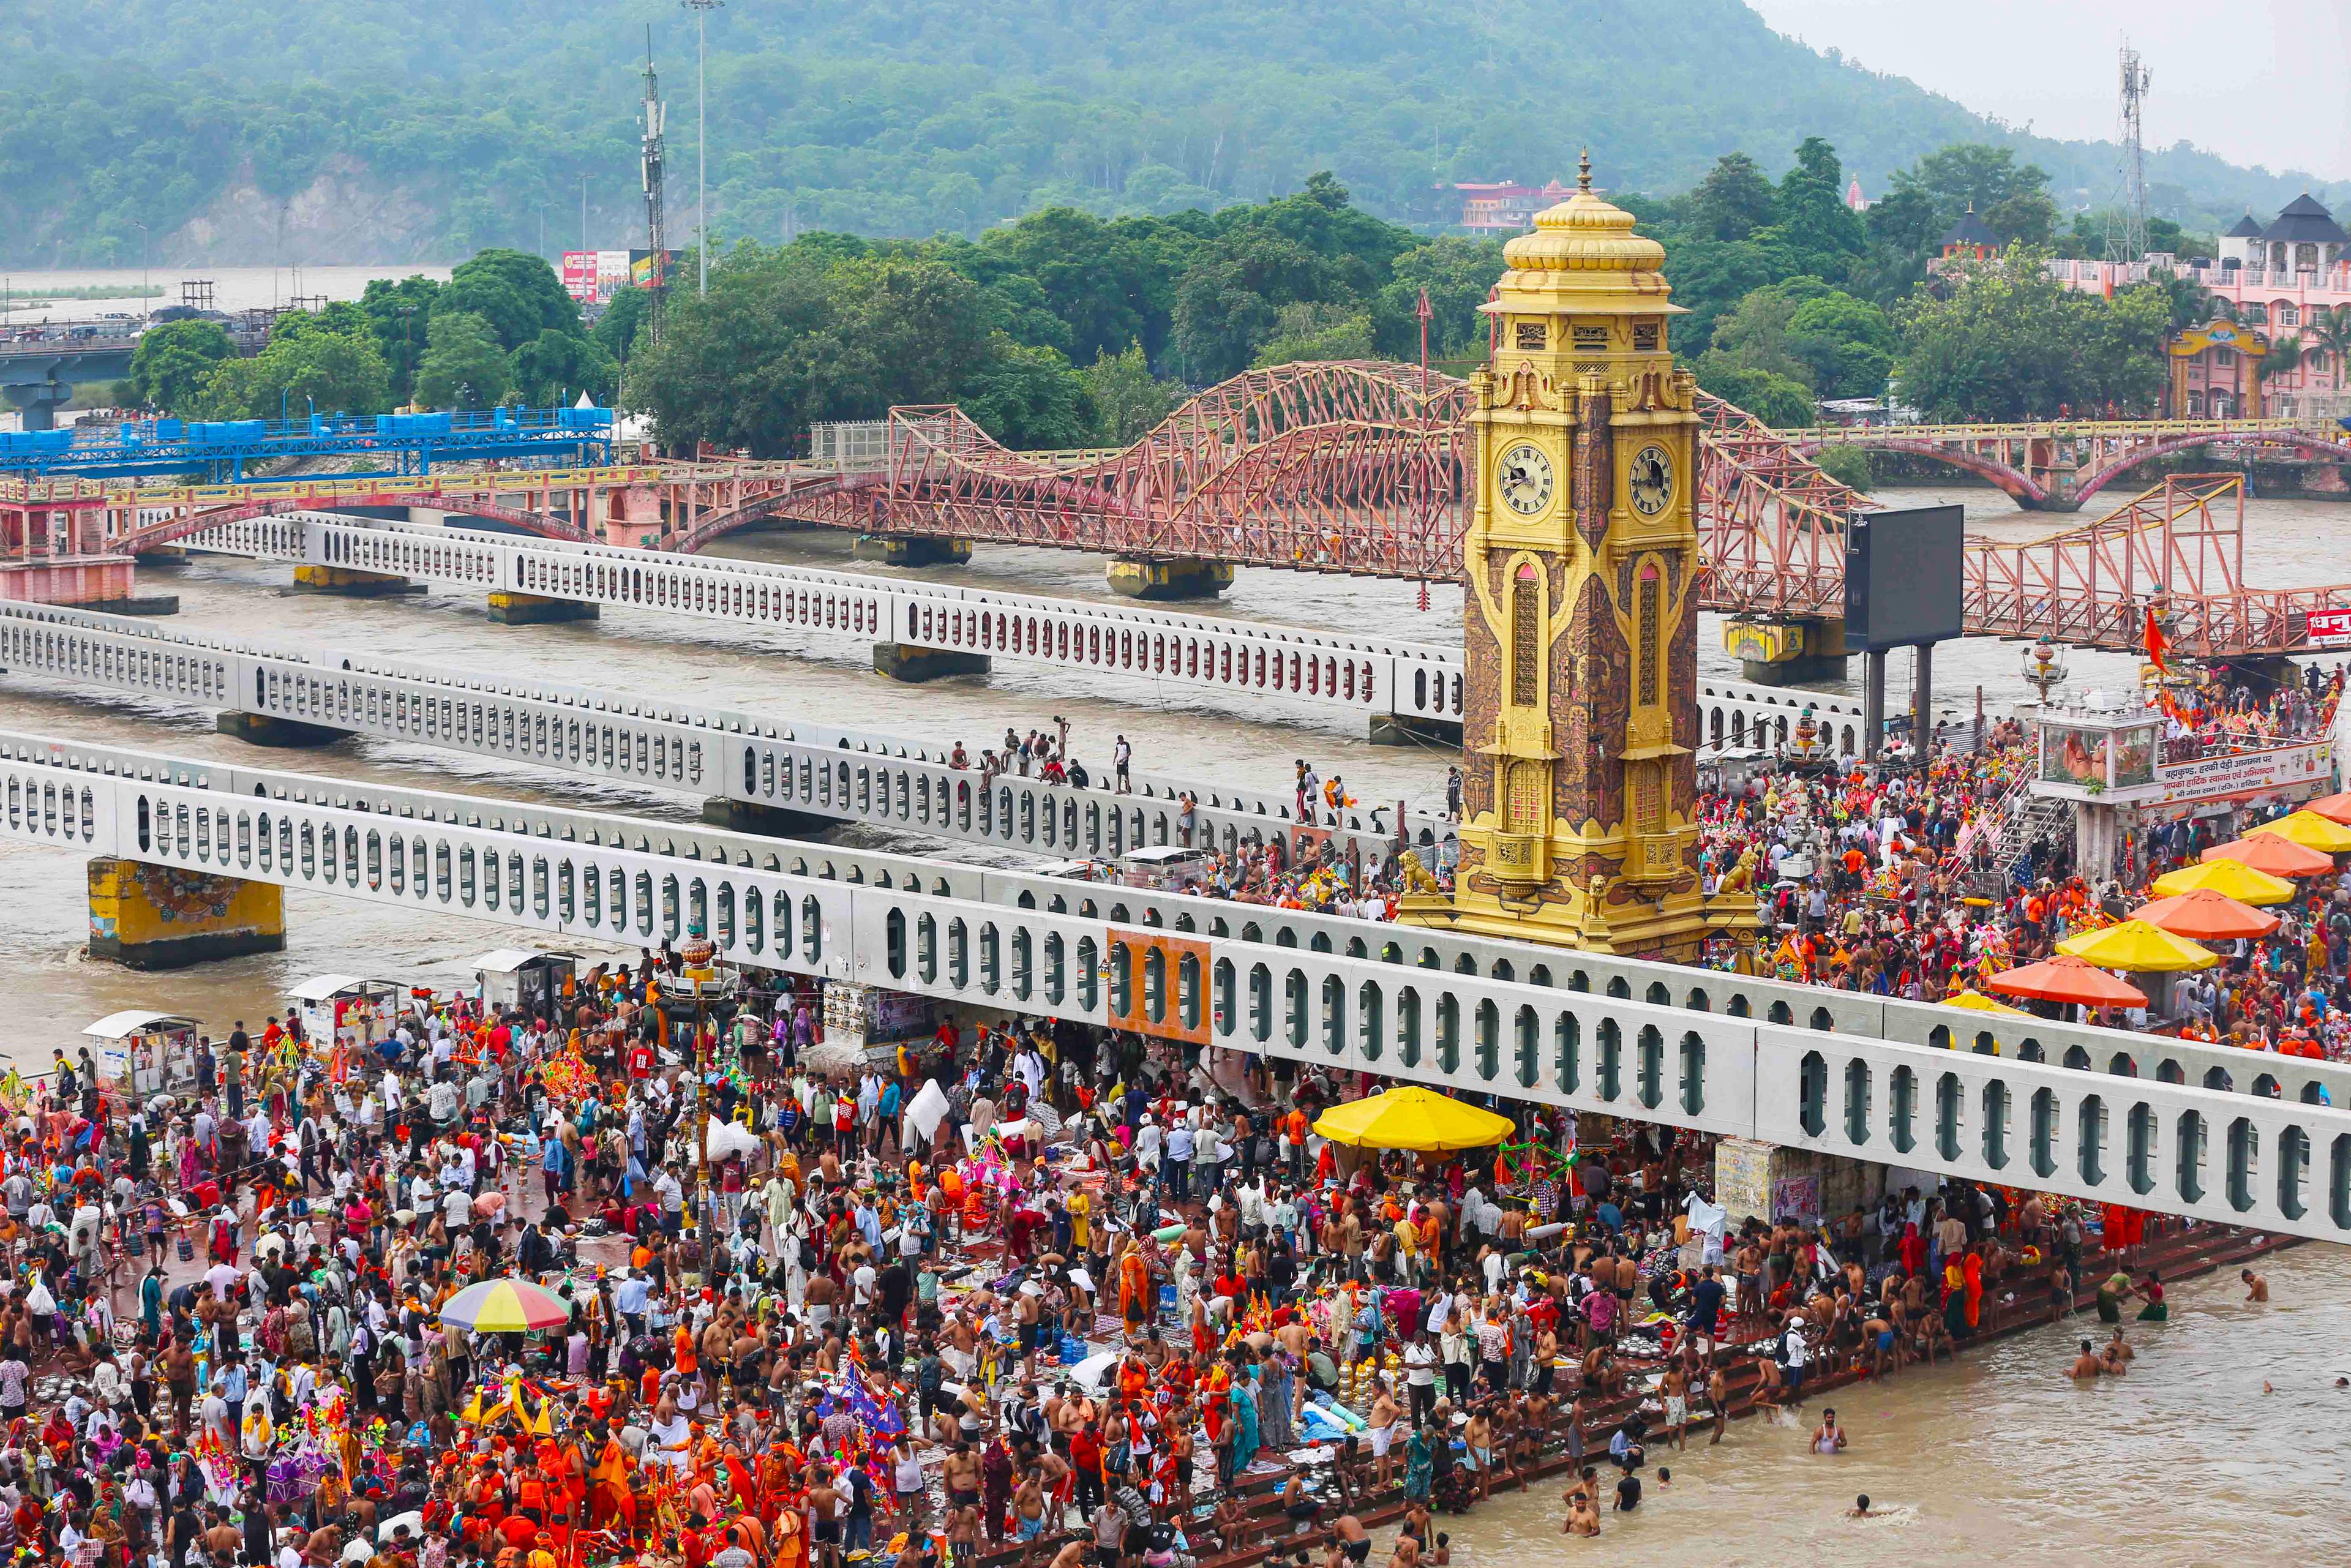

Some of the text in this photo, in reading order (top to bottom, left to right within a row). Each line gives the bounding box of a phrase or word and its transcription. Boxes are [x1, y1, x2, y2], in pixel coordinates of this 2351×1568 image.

[2199, 761, 2218, 773] हरकी
[2220, 759, 2232, 771] पैड़ी
[2234, 757, 2261, 767] आगमन
[2186, 775, 2207, 787] हार्दिक
[2209, 773, 2230, 783] स्वागत
[2232, 770, 2241, 779] एवं
[2243, 767, 2274, 778] अभिनन्दन
[2218, 782, 2238, 792] (रजि.)
[2241, 779, 2261, 788] हरिद्वार
